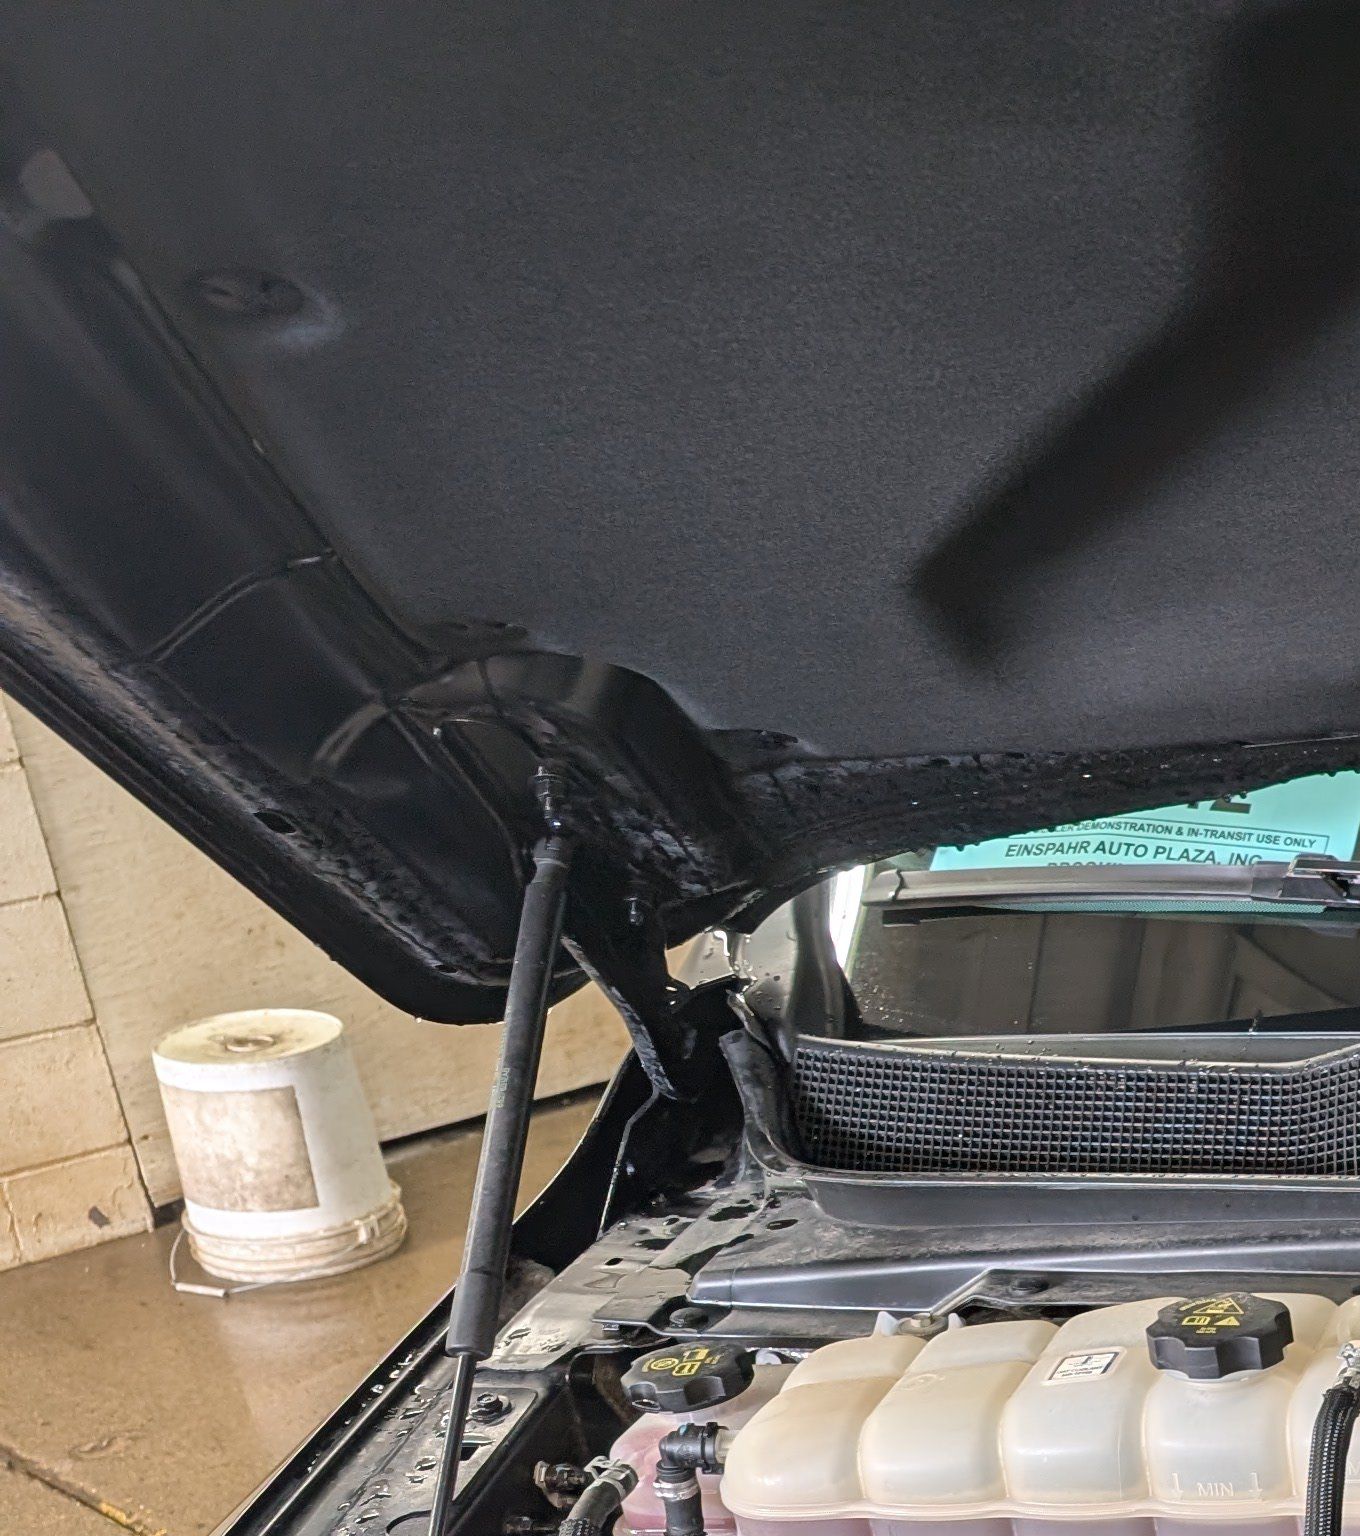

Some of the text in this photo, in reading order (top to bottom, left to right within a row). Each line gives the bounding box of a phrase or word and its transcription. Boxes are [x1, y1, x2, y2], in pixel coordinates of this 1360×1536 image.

[1076, 820, 1173, 835] DEMONSTRATION
[1175, 825, 1184, 836] &
[1187, 827, 1254, 842] IN-TRANSIT
[1256, 834, 1281, 845] USE
[1284, 836, 1317, 849] ONLY
[1005, 840, 1092, 857] EINSPAHR
[1094, 840, 1149, 858] AUTO
[1196, 1482, 1236, 1497] MIN
